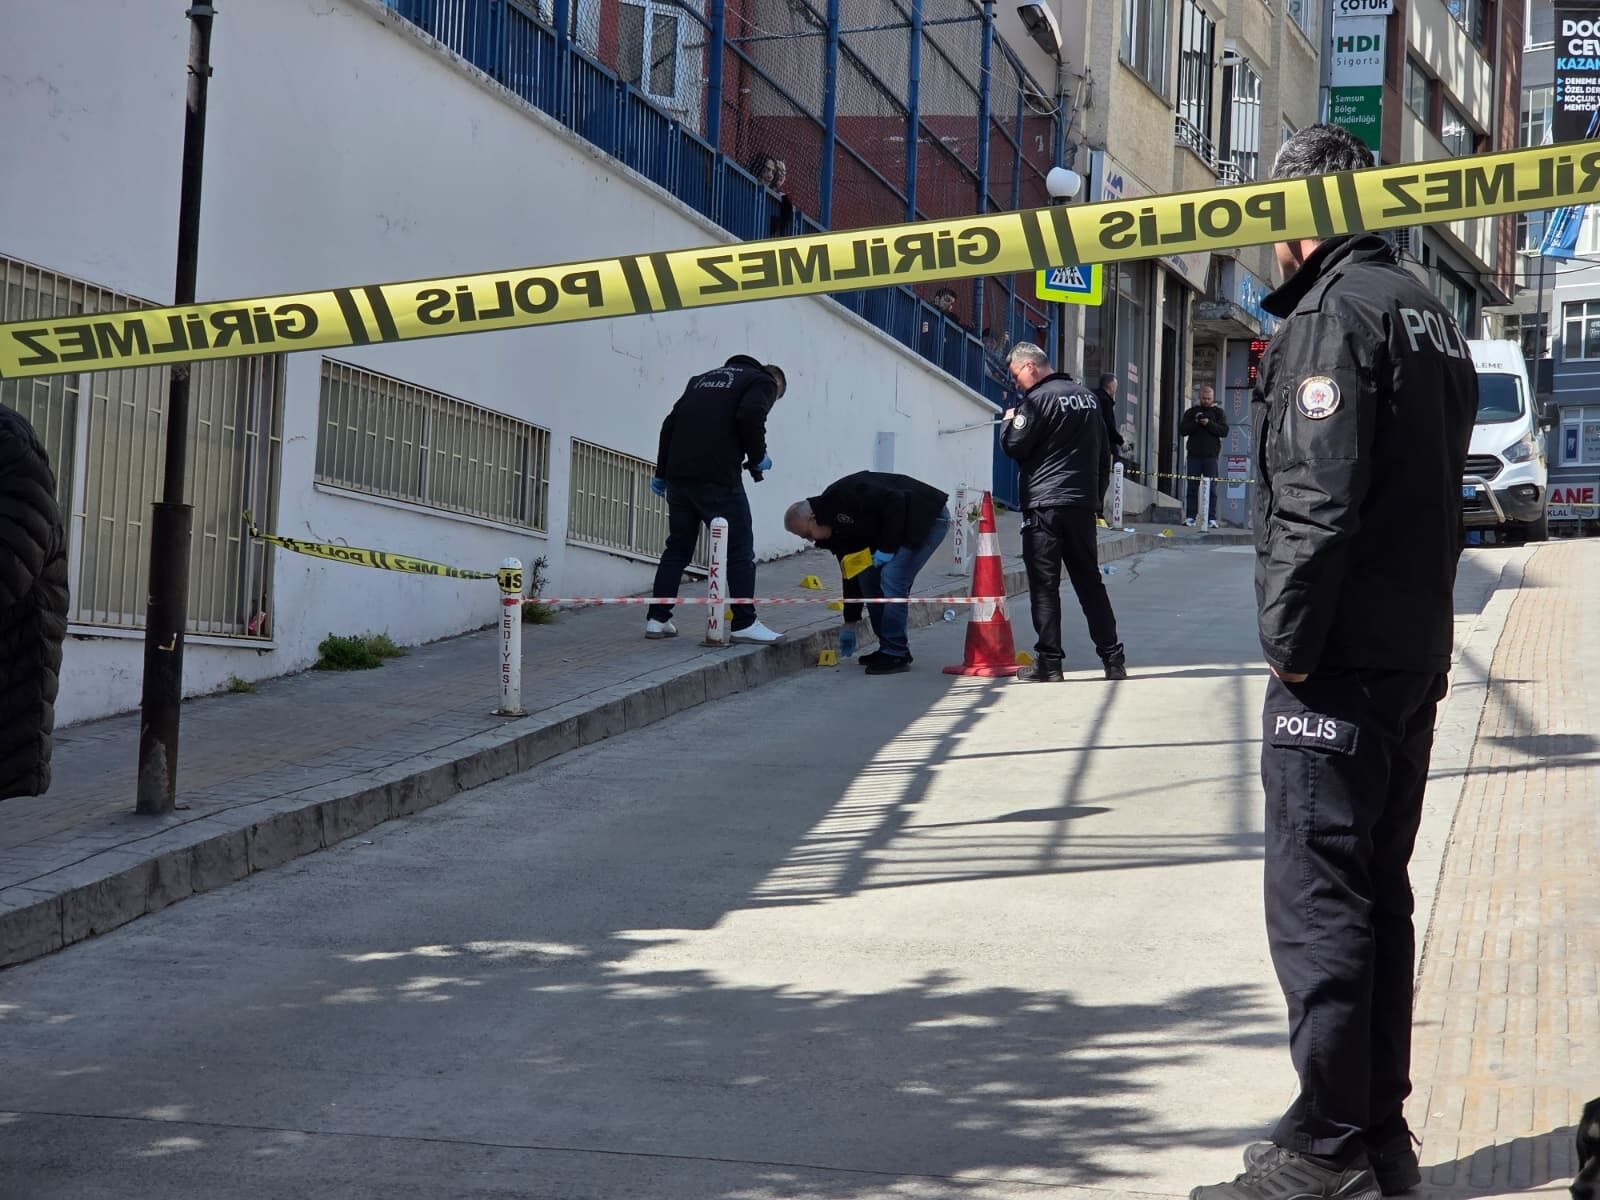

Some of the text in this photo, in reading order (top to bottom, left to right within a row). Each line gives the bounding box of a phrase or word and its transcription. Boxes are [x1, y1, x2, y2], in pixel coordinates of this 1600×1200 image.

[1337, 34, 1380, 53] HDI
[1337, 57, 1380, 67] Sigorta
[1565, 85, 1584, 93] ÖZEL
[1565, 95, 1595, 103] KOÇLUK
[1335, 105, 1356, 114] Bölge
[1334, 114, 1376, 124] Müdürlüğü
